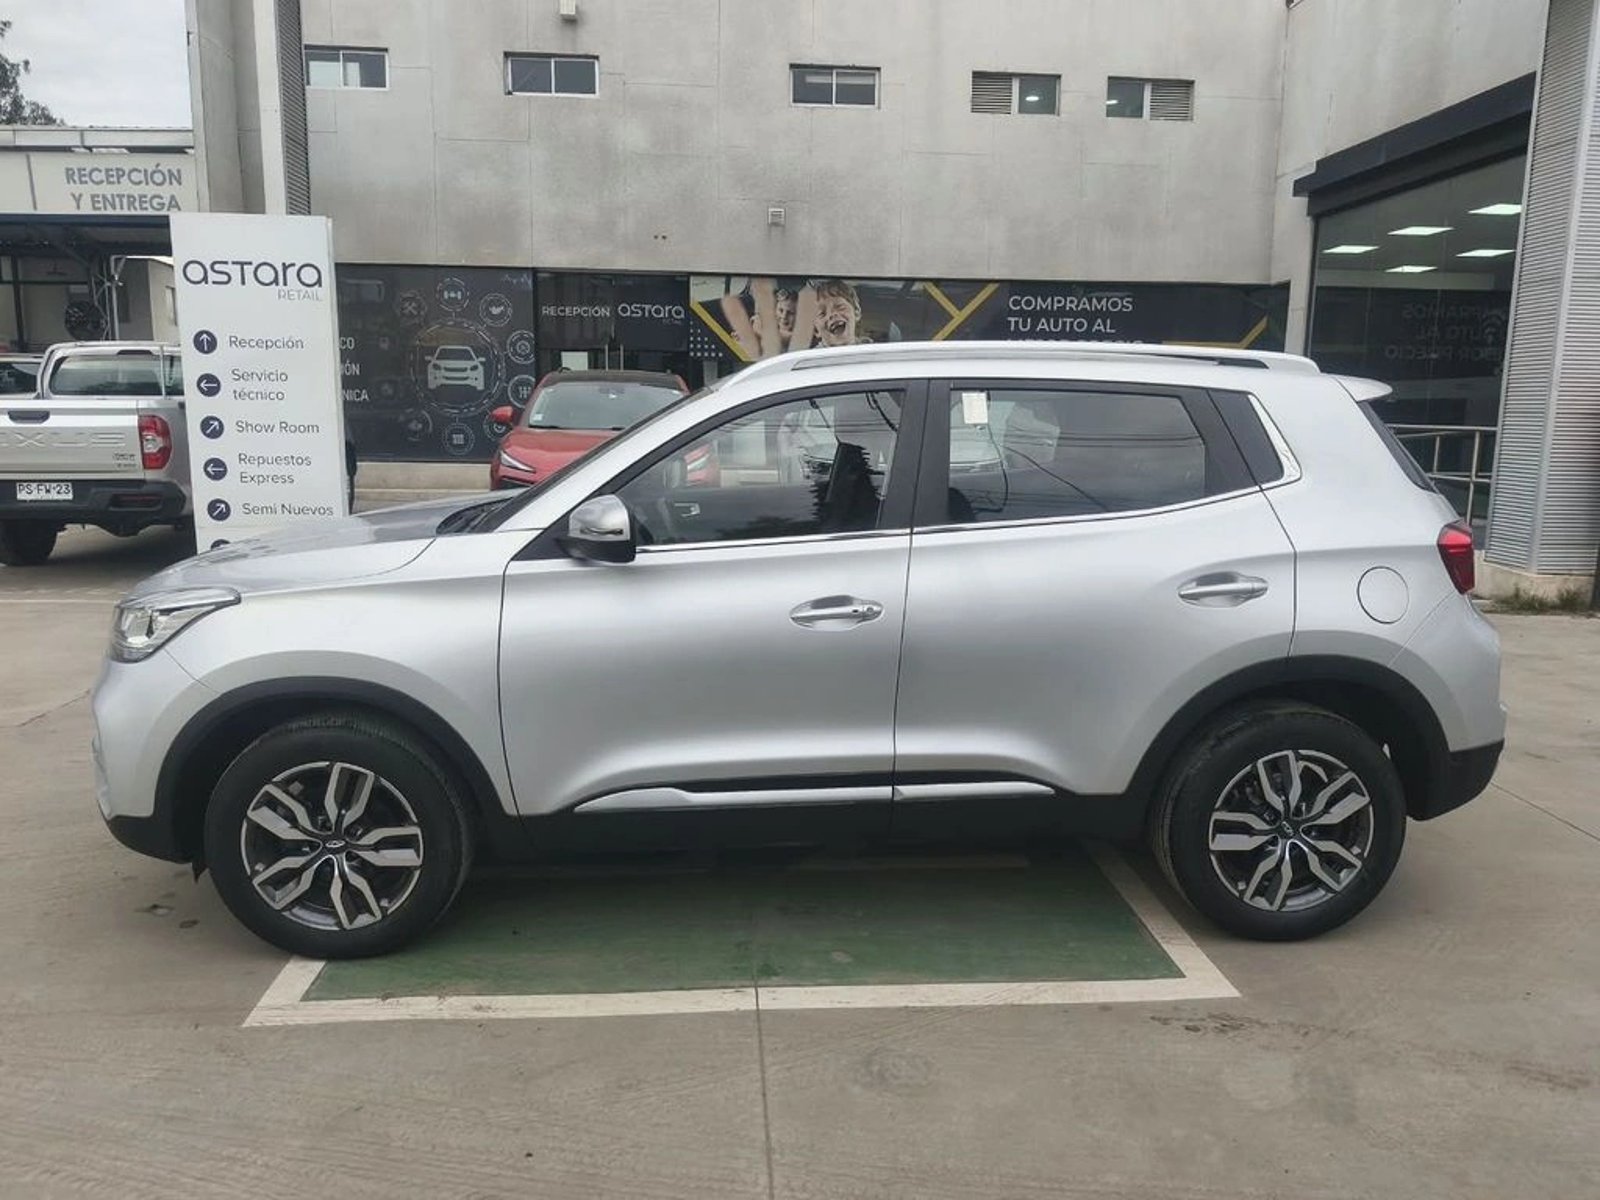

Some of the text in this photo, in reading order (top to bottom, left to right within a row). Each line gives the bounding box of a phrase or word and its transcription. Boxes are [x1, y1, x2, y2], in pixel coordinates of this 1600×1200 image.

[65, 163, 182, 187] RECEPCIÓN
[71, 193, 181, 211] Y ENTREGA
[182, 259, 322, 288] astara
[277, 289, 321, 301] RETAIL
[541, 303, 610, 317] RECEPCIÓN
[1008, 295, 1133, 312] COMPRAMOS
[1007, 317, 1116, 333] TU AUTO AL
[229, 335, 304, 350] Recepción
[231, 368, 288, 382] Servicio
[232, 387, 285, 401] técnico
[235, 420, 320, 434] Show Room
[238, 452, 312, 467] Repuestos
[240, 472, 295, 486] Express
[242, 502, 334, 516] Semi Nuevos
